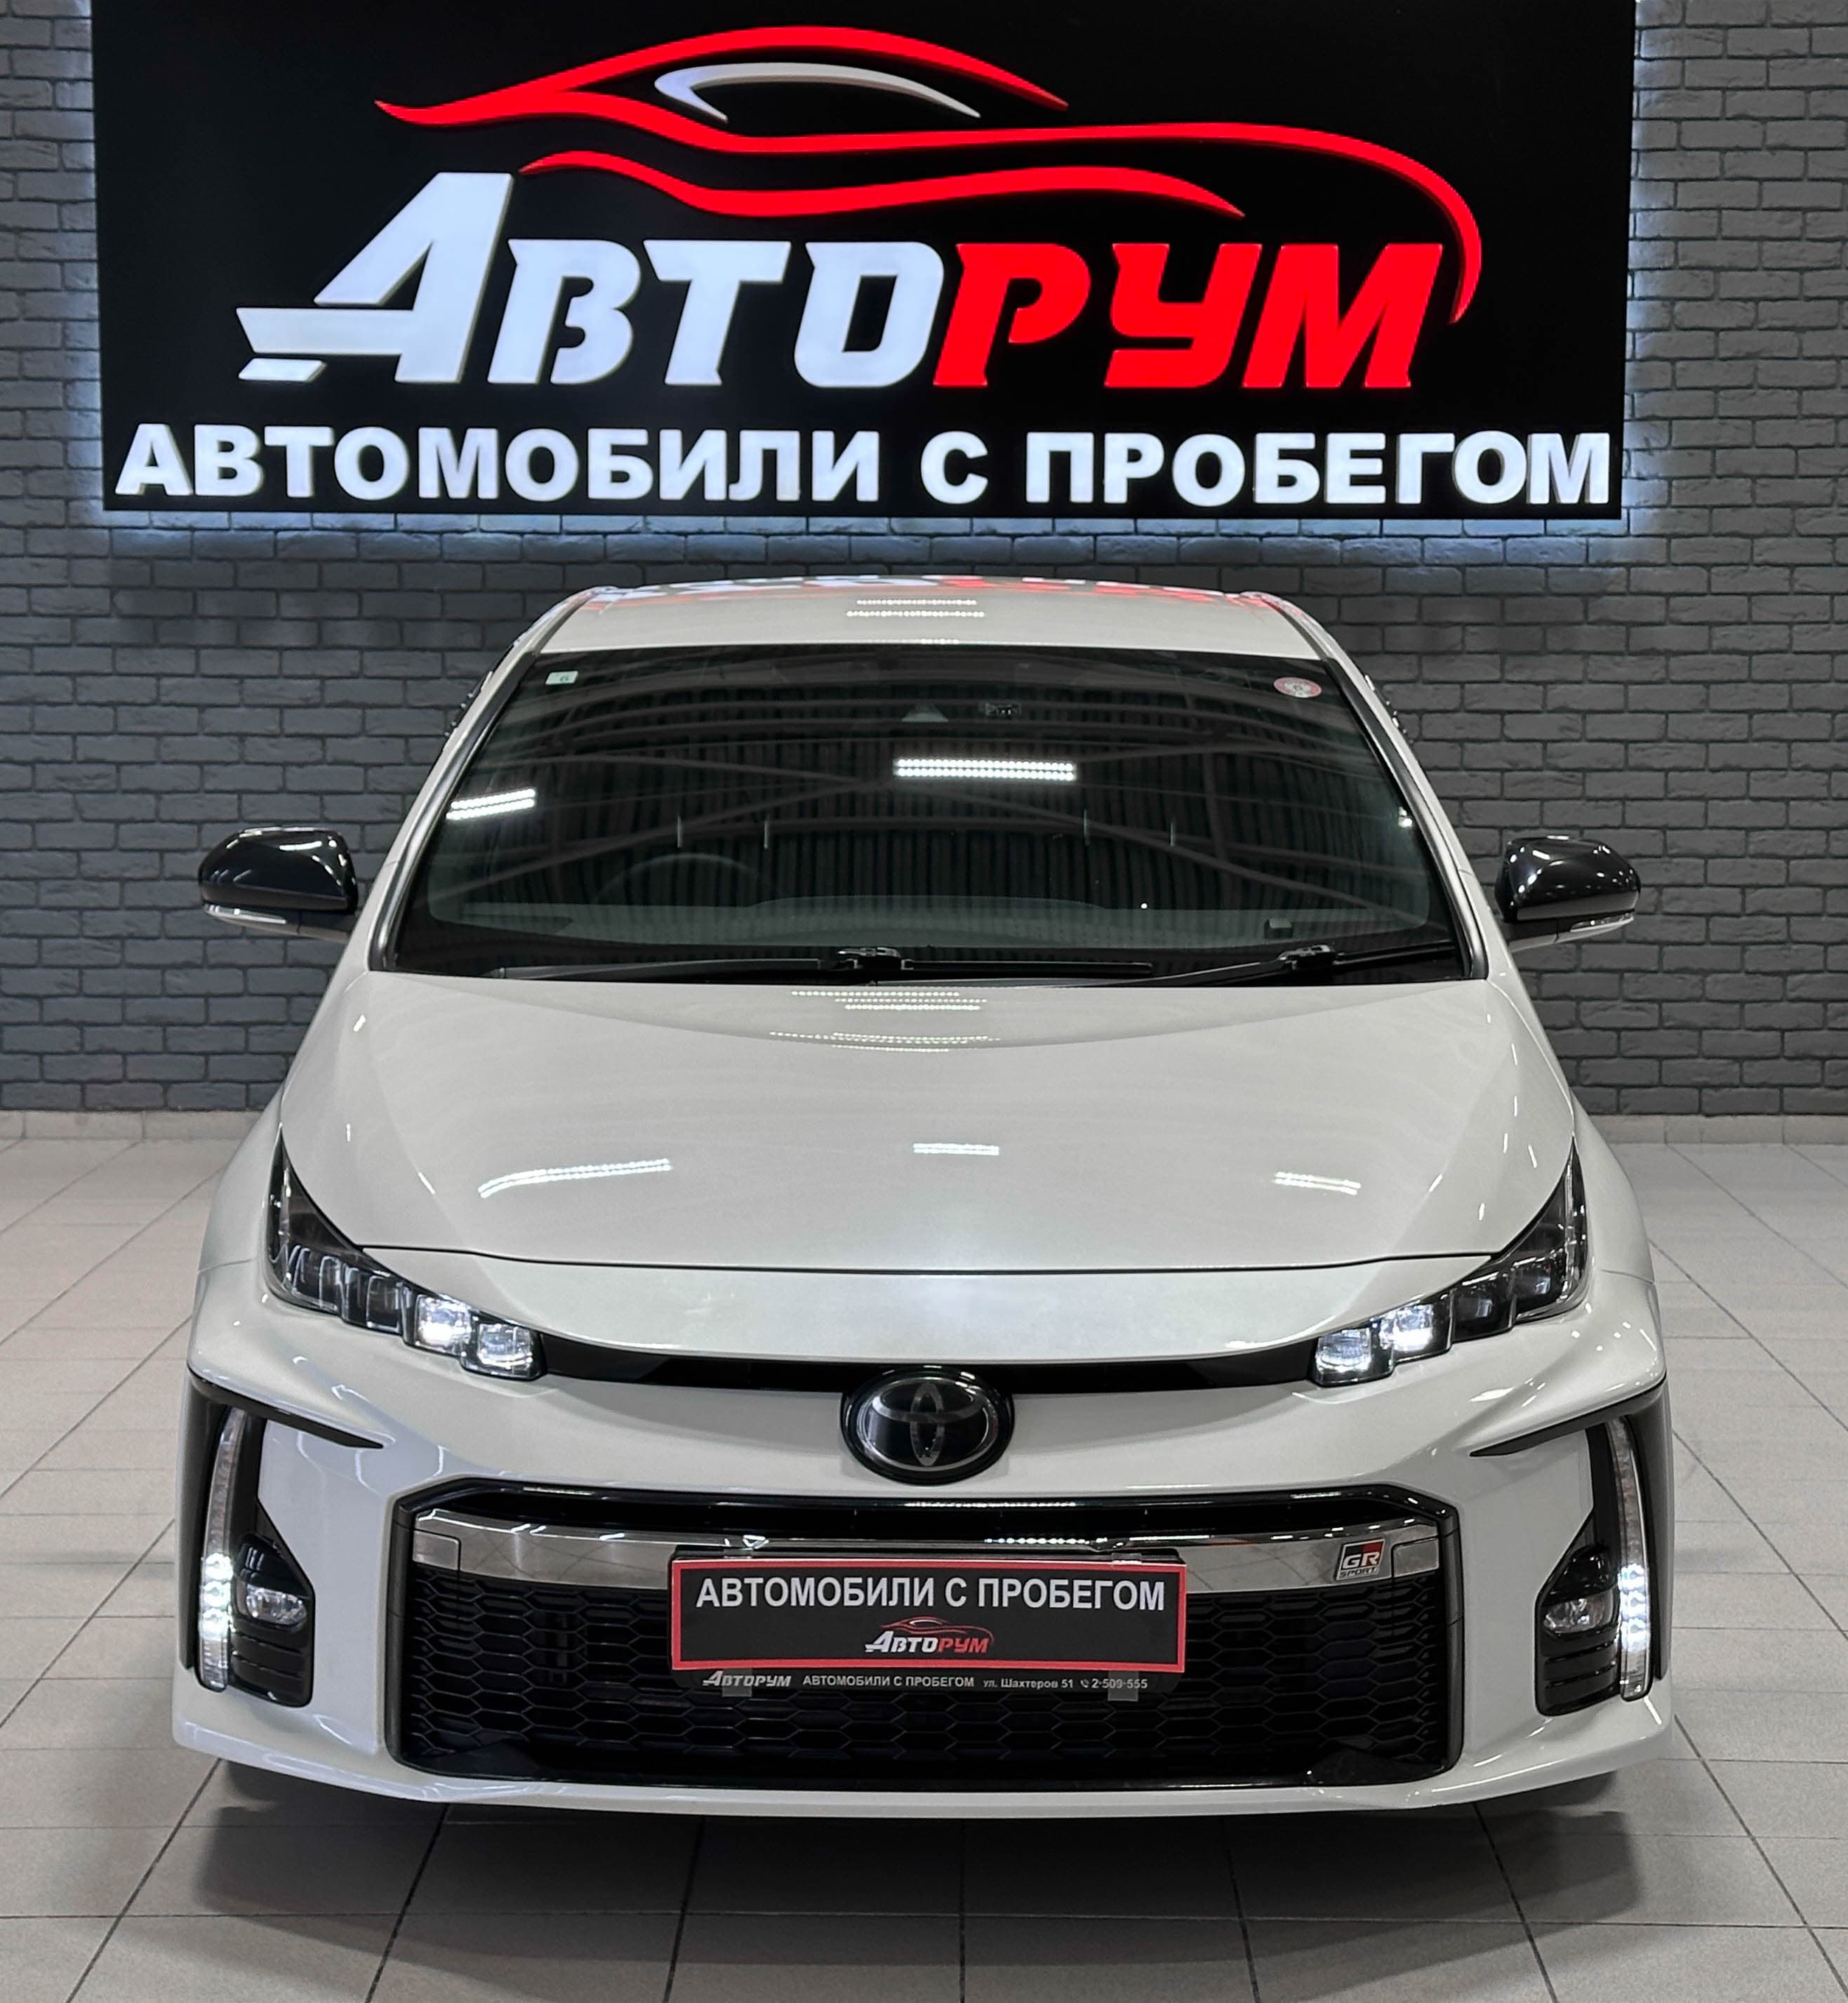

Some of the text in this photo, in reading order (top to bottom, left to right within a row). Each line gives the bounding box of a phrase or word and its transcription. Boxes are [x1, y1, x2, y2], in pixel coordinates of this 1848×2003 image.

[116, 423, 1611, 507] АВТОМОБИЛИ С ПРОБЕГОМ
[1342, 1550, 1380, 1569] GR
[1340, 1566, 1377, 1578] SPORT
[696, 1576, 1164, 1611] АВТОМОБИЛИ С ПРОБЕГОМ
[802, 1675, 891, 1686] АВТОМОБИЛИ
[893, 1675, 903, 1686] С
[905, 1675, 975, 1688] ПРОБЕГОМ
[983, 1679, 998, 1689] ул.
[1001, 1678, 1058, 1690] Шахтеров
[1061, 1679, 1074, 1689] 51
